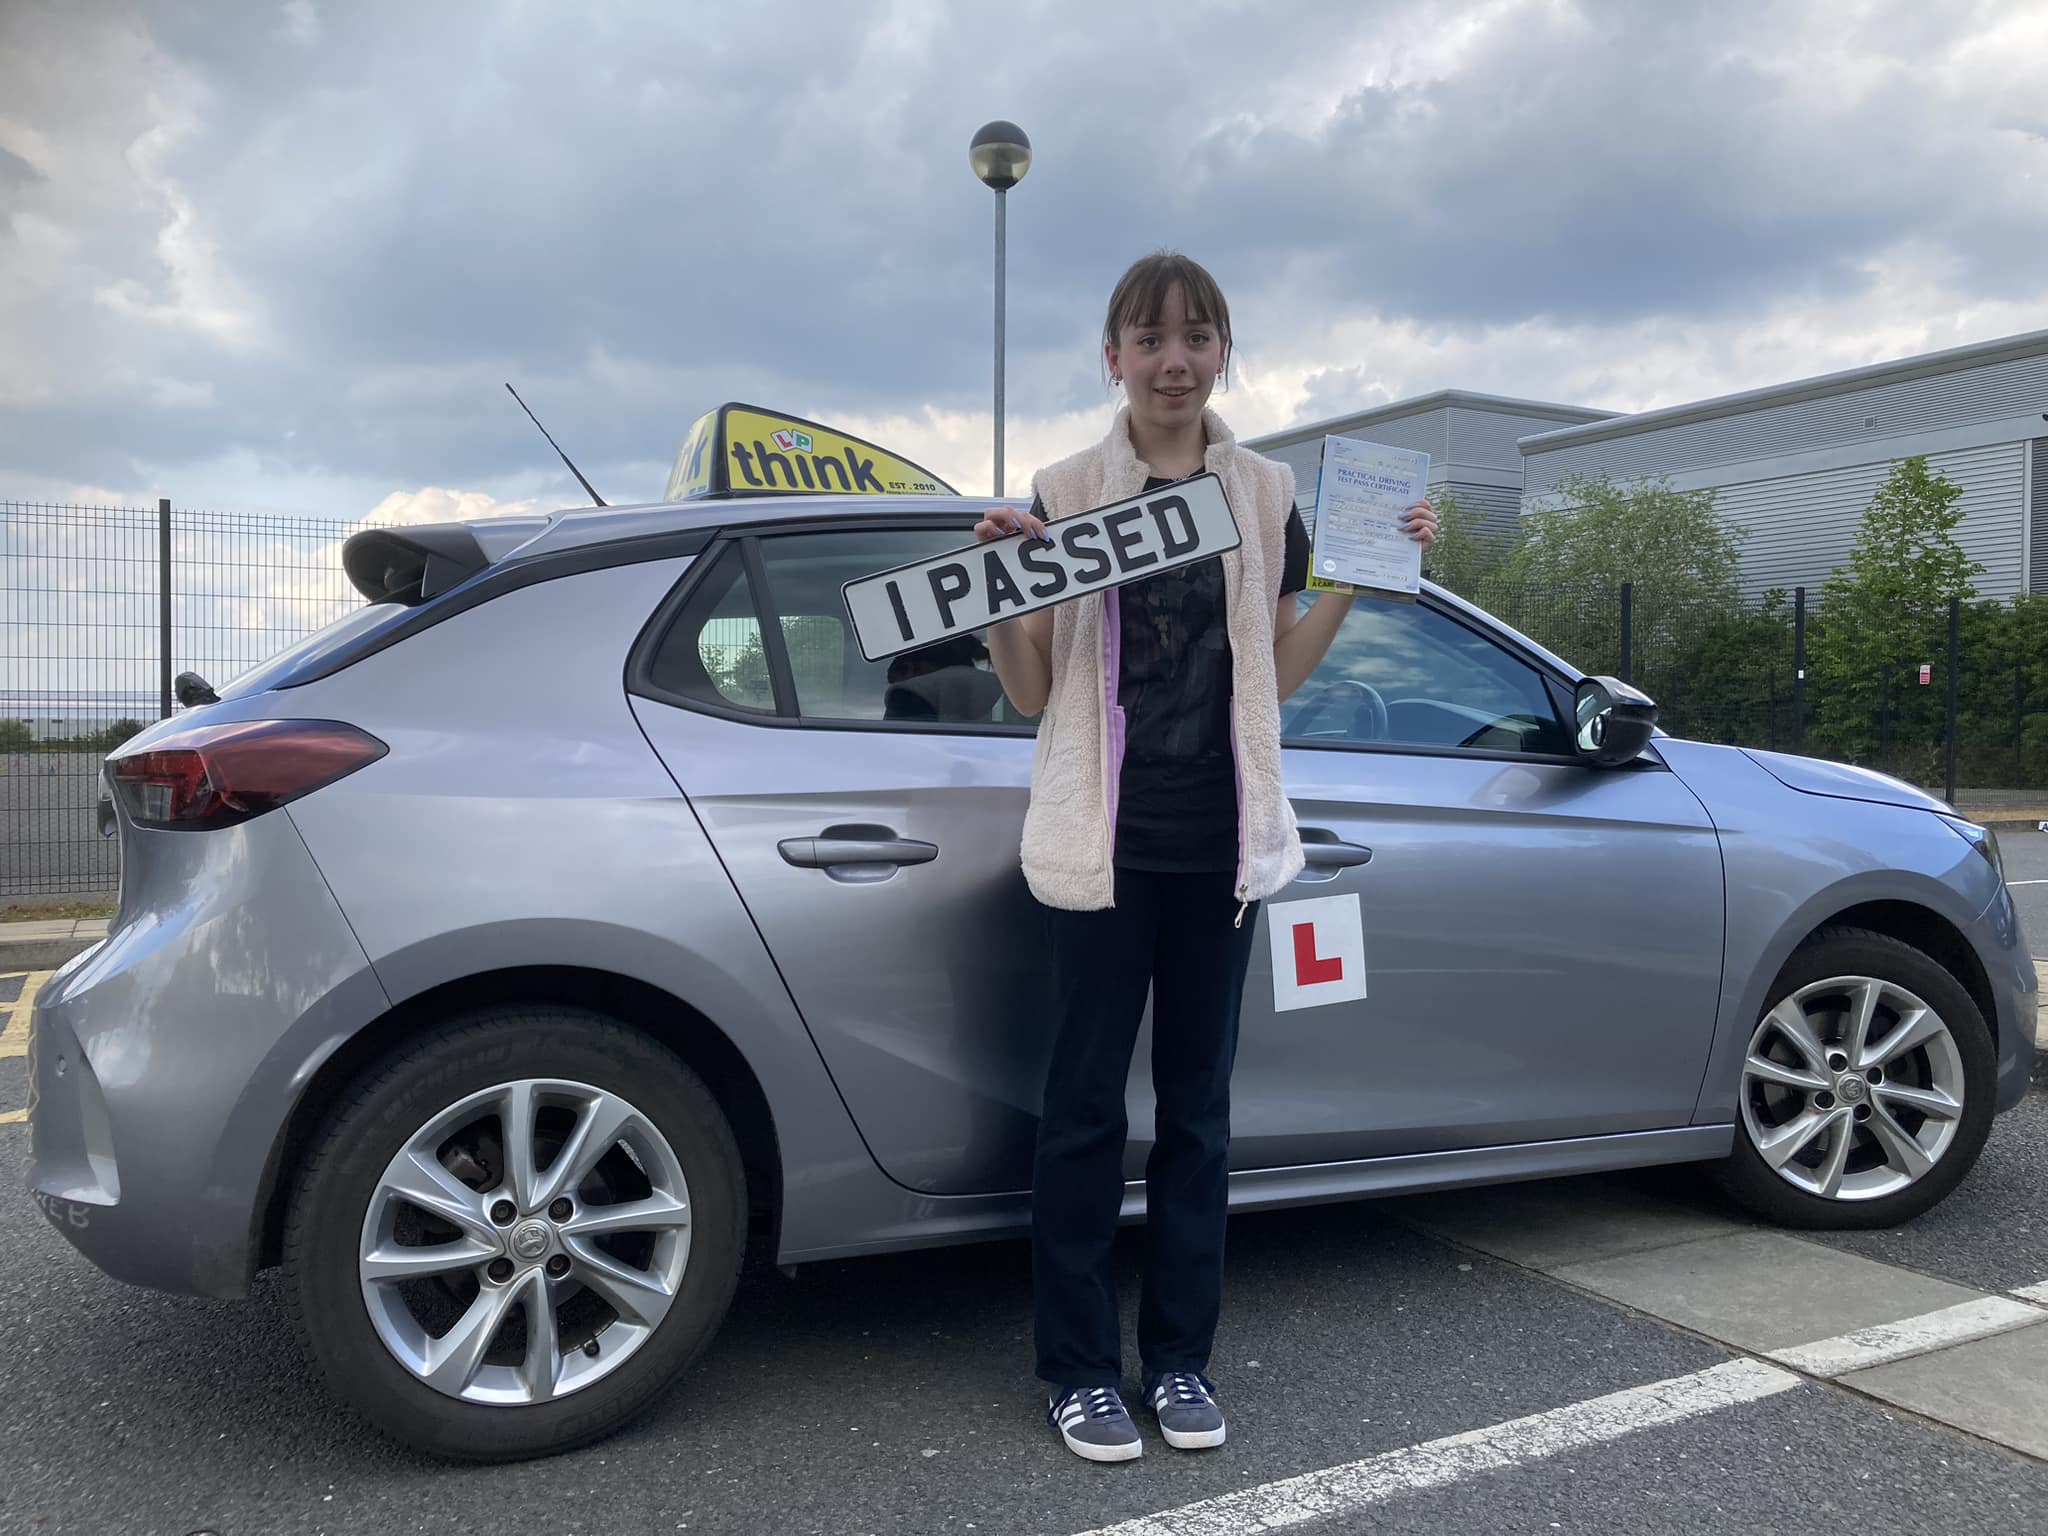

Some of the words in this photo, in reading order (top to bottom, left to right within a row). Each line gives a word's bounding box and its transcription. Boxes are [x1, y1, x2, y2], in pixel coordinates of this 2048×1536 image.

[775, 433, 793, 449] L
[796, 433, 810, 447] P
[731, 440, 885, 493] think
[912, 483, 936, 491] 2010
[1337, 468, 1376, 482] PRACTICAL
[1379, 476, 1411, 489] DRIVING
[1337, 475, 1352, 484] TEST
[1353, 479, 1369, 487] PASS
[1370, 482, 1409, 495] CERTIFICATE
[885, 580, 914, 642] I
[926, 495, 1200, 629] PASSED
[1292, 922, 1343, 986] L
